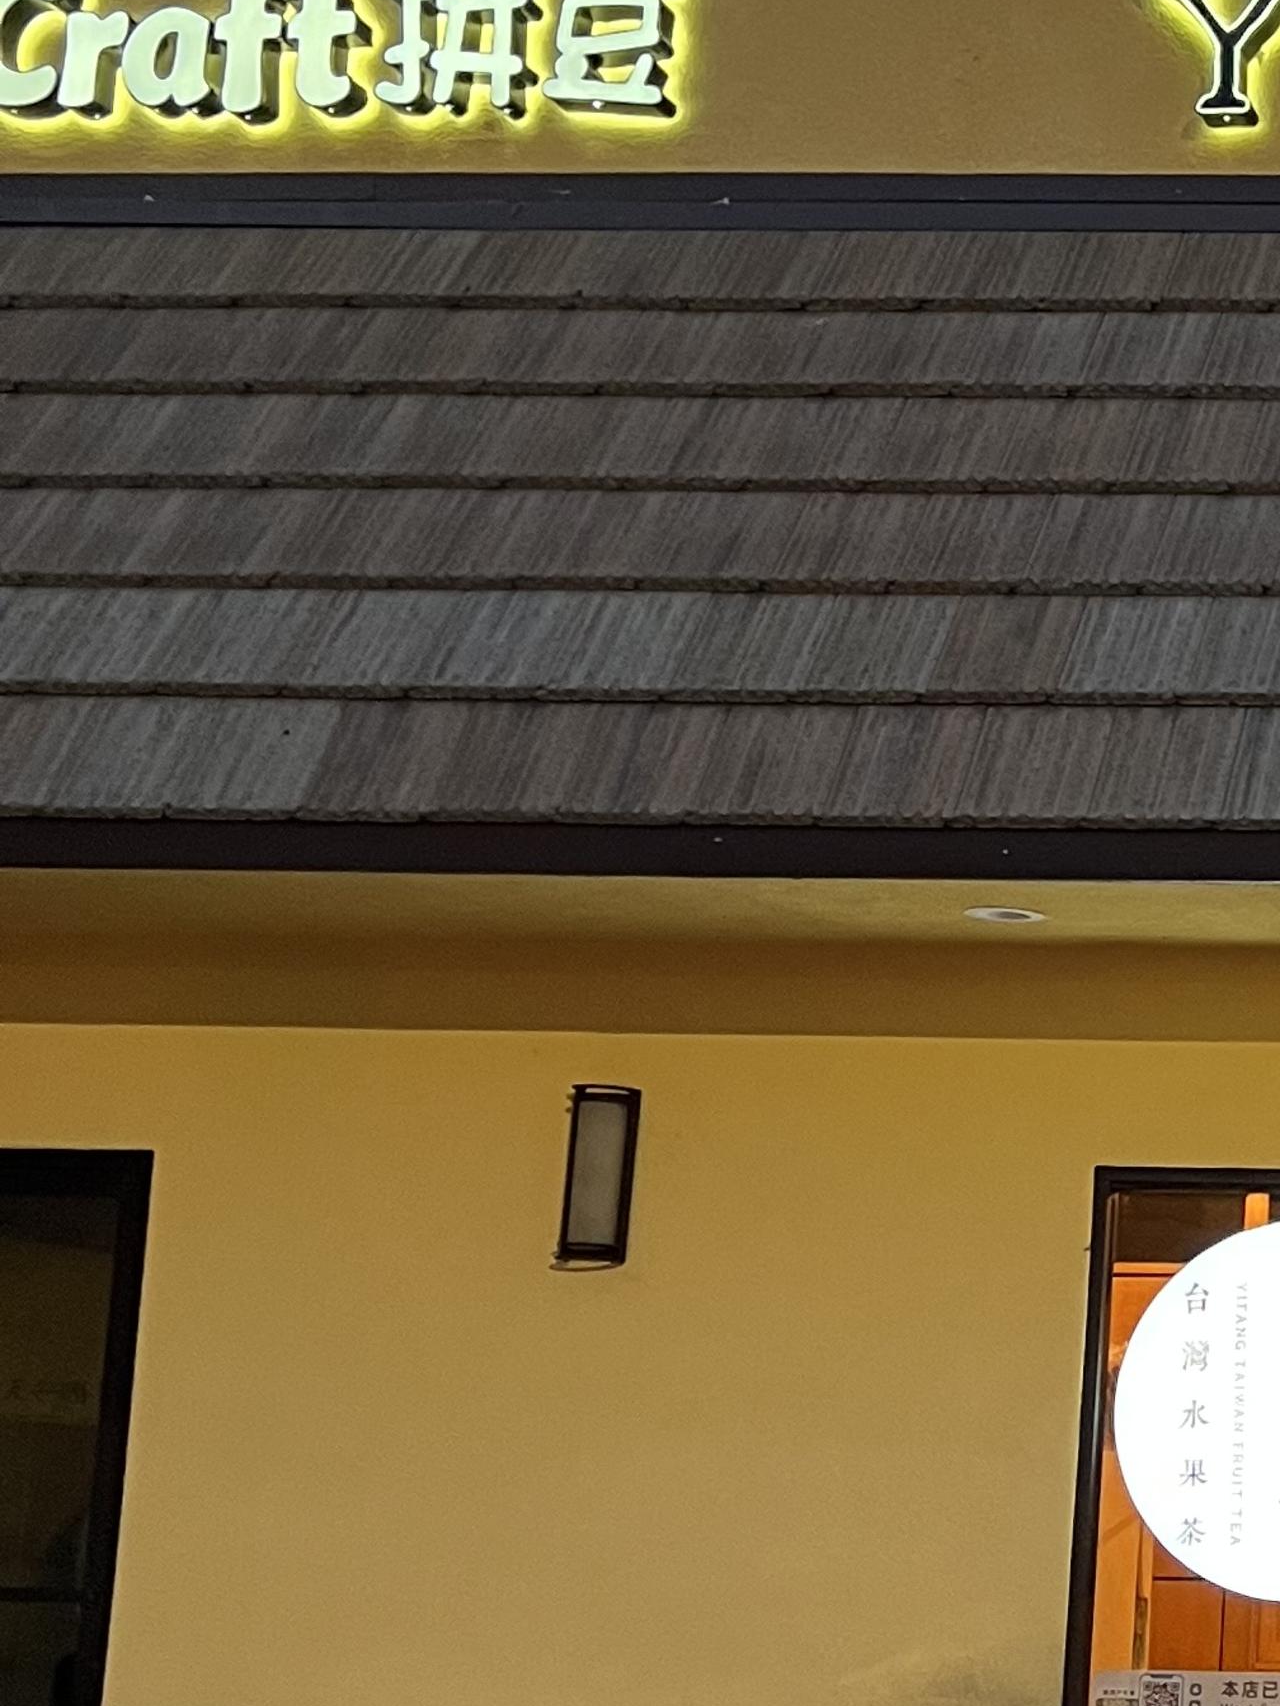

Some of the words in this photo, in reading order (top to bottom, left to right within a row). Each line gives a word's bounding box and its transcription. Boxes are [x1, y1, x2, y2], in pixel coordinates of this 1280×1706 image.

[1176, 1282, 1210, 1546] 台灣水果茶
